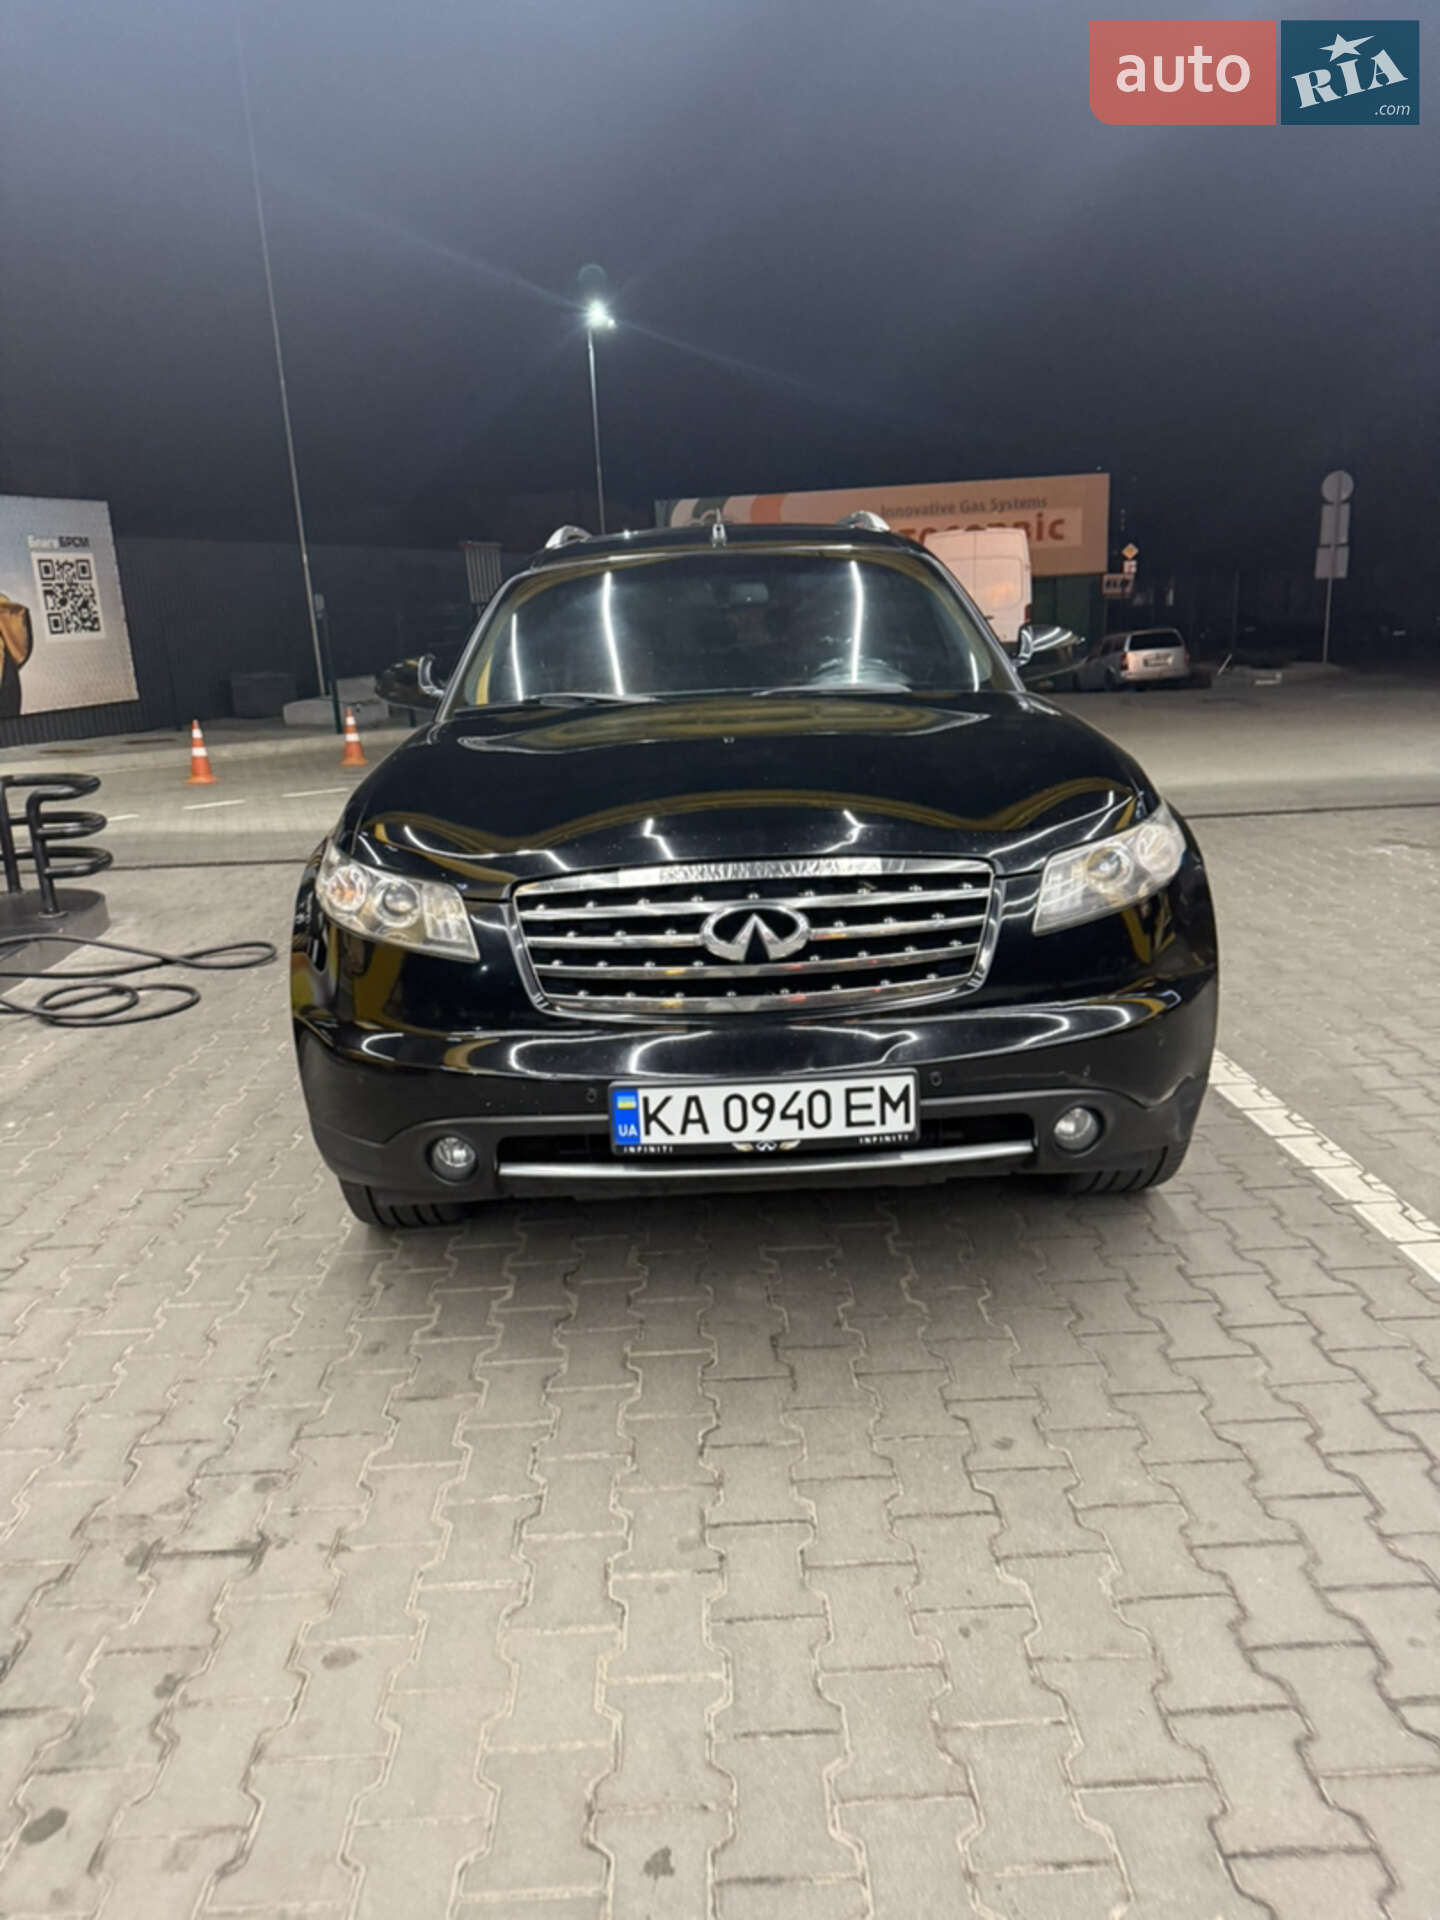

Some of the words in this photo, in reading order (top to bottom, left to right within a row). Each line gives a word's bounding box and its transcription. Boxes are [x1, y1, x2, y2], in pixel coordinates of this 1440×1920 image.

[881, 502, 955, 518] Innovative
[959, 499, 985, 514] Gas
[991, 497, 1048, 513] Systems
[642, 1095, 710, 1136] KA
[723, 1089, 831, 1133] 0940
[845, 1084, 910, 1128] EM
[618, 1124, 638, 1137] UA
[859, 1134, 909, 1144] INFINITI
[623, 1145, 673, 1153] INFINITI
